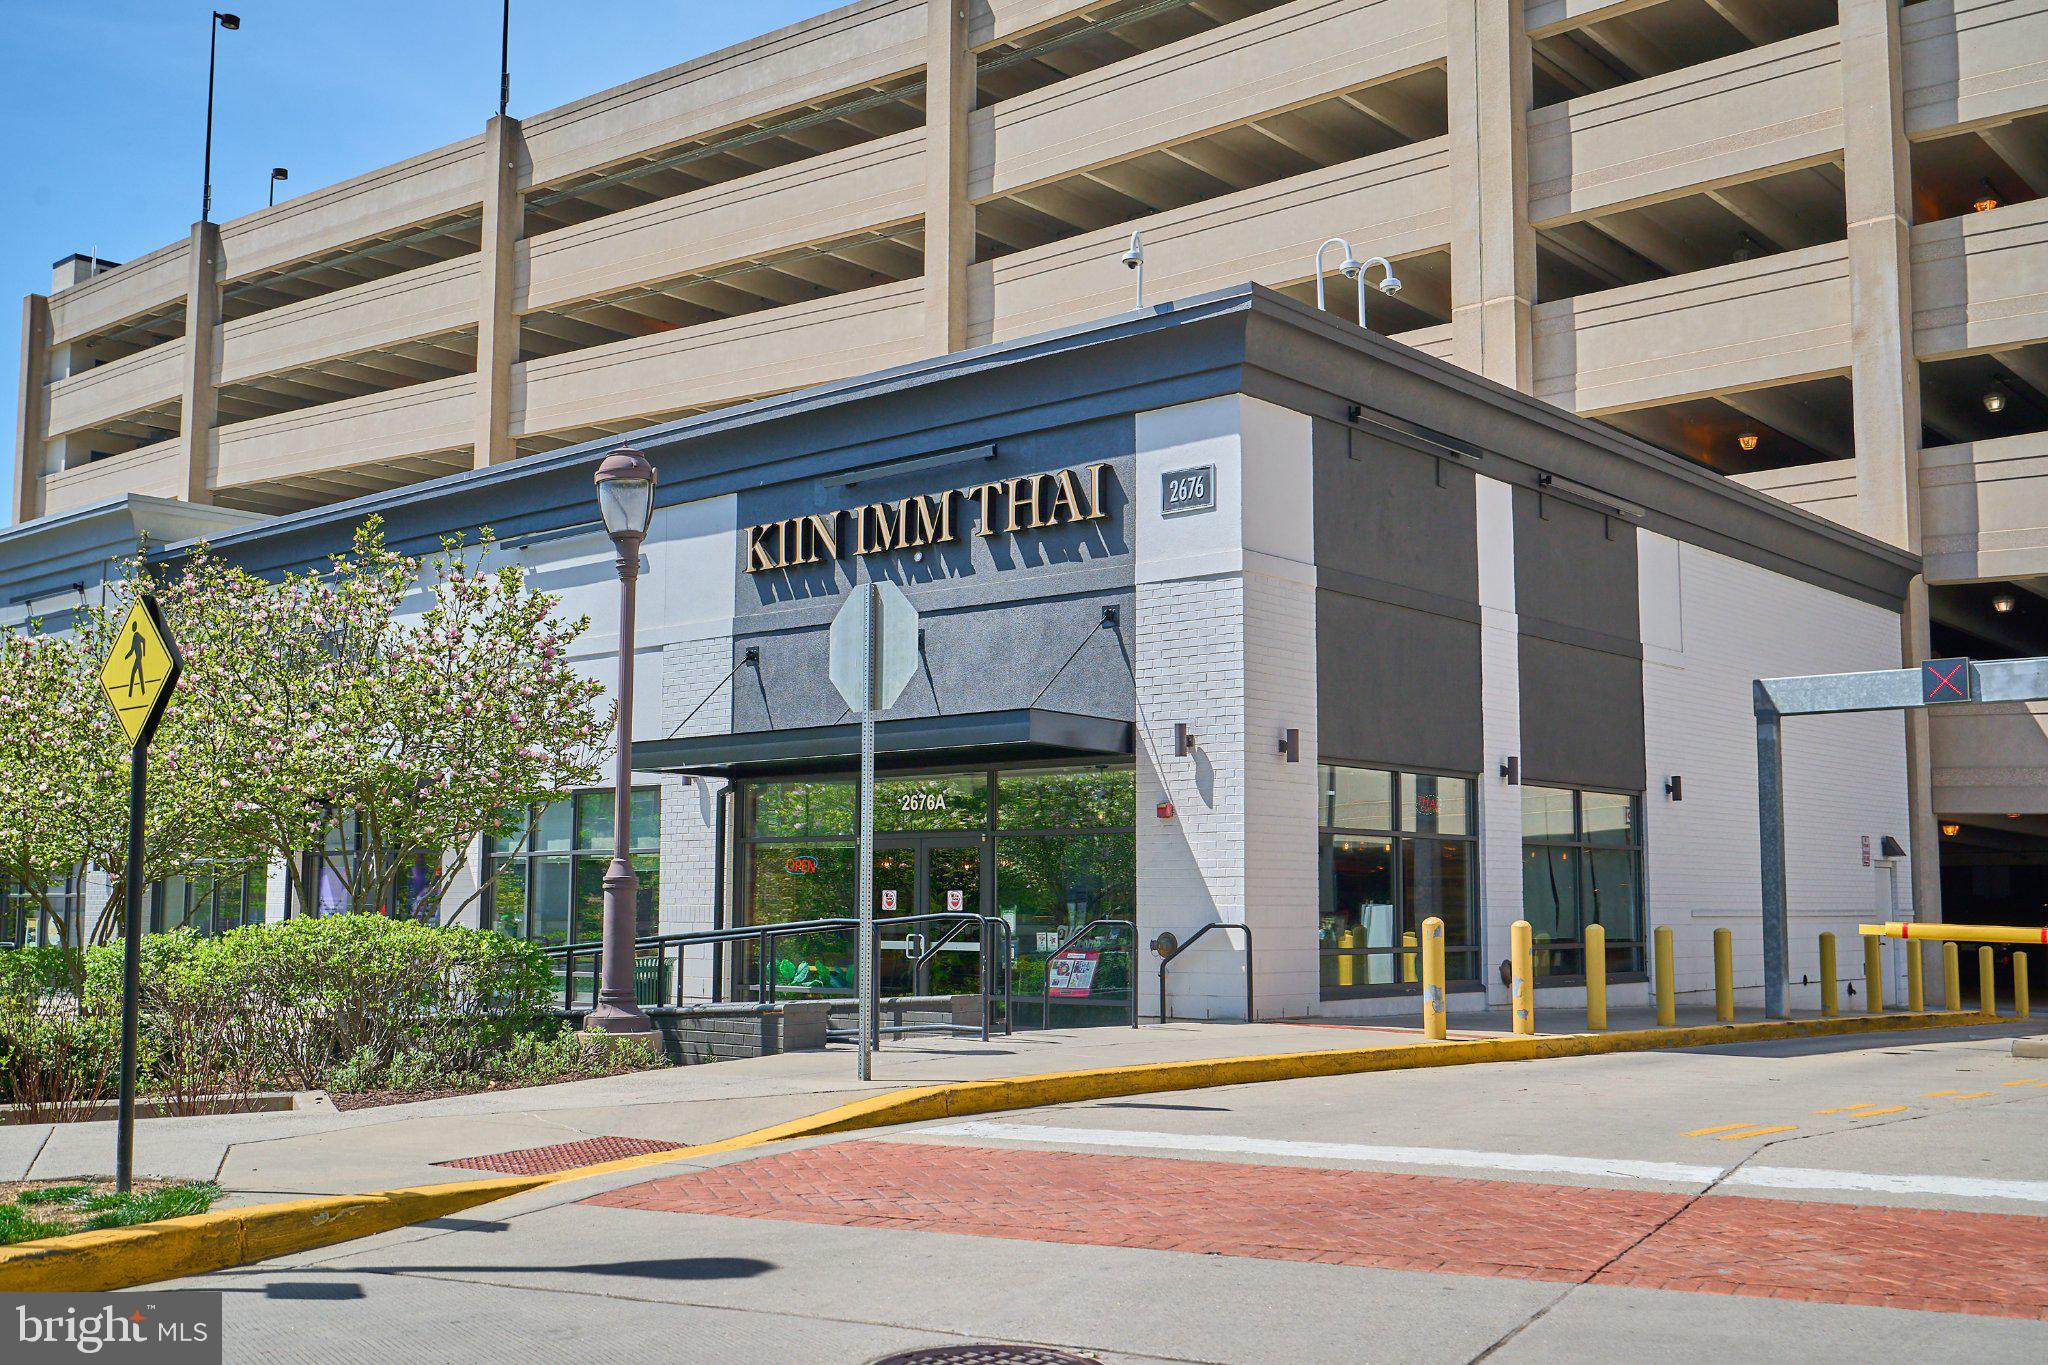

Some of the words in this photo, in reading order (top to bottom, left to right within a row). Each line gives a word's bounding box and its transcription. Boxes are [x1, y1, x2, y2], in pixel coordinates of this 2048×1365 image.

[1169, 475, 1205, 503] 2676
[743, 510, 853, 573] KIIN
[852, 489, 955, 556] IMM
[967, 462, 1106, 537] THAI
[901, 793, 947, 811] 2676A
[785, 858, 816, 874] OPEN
